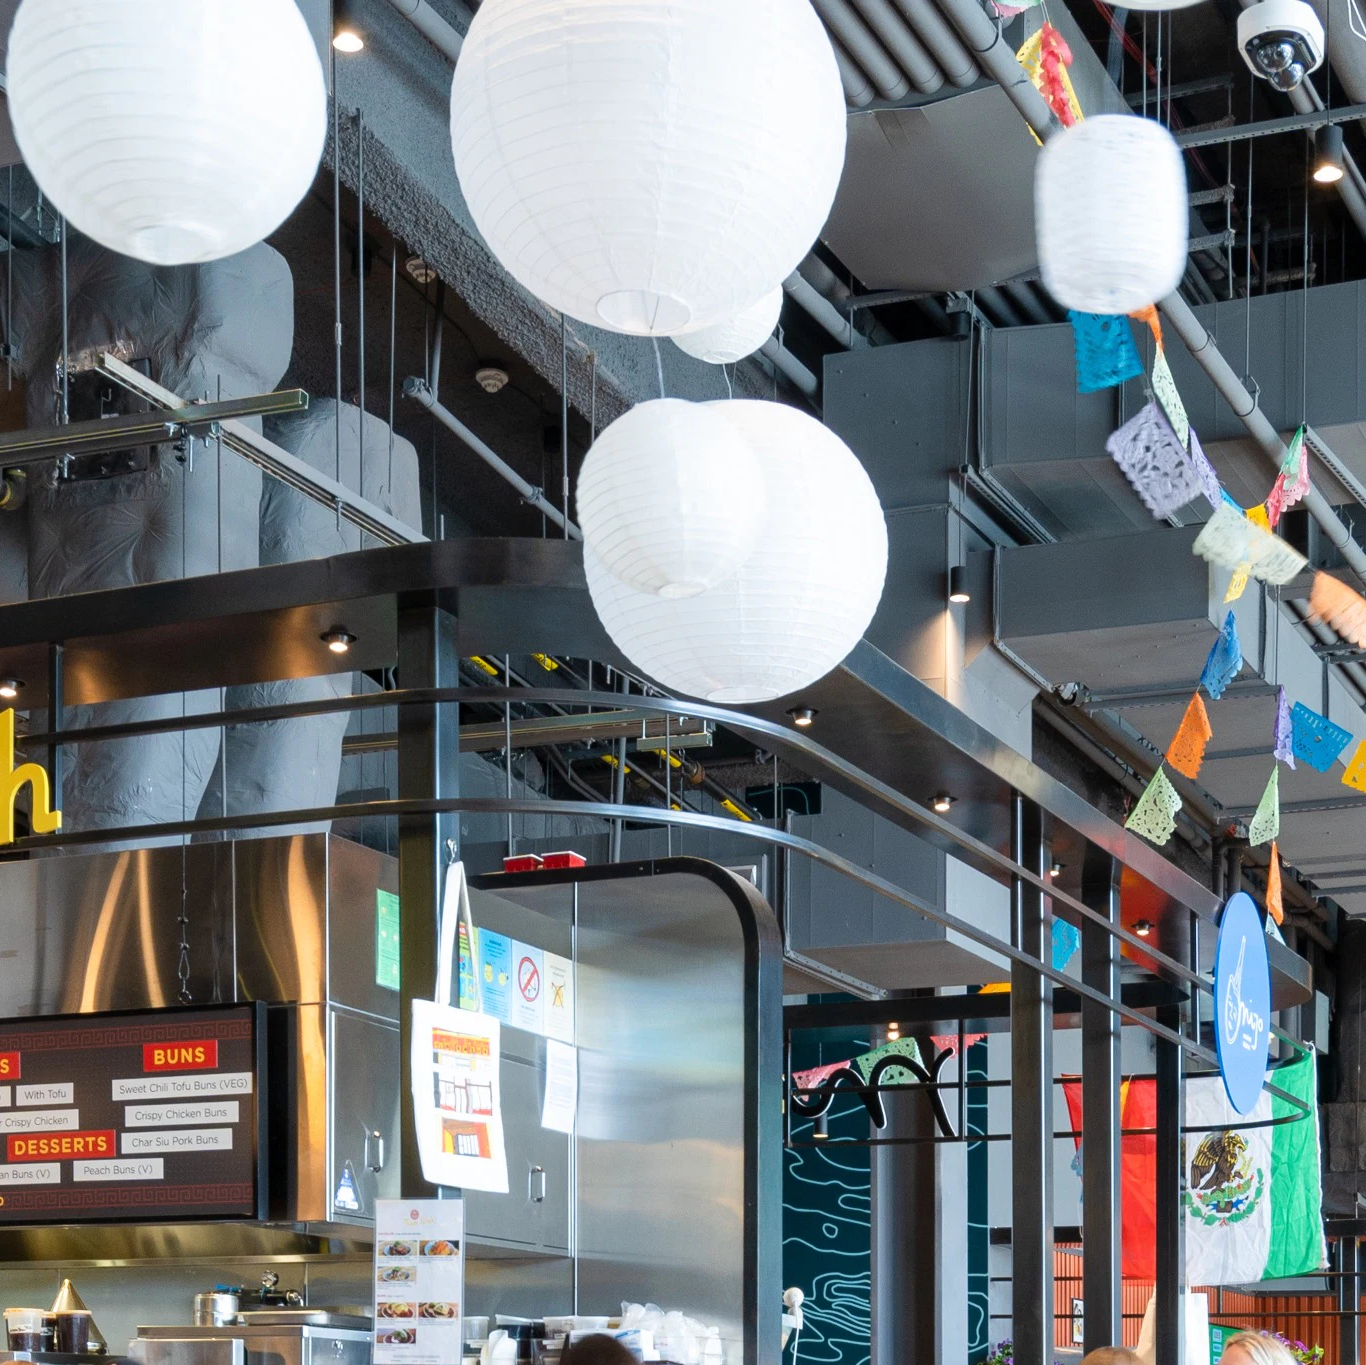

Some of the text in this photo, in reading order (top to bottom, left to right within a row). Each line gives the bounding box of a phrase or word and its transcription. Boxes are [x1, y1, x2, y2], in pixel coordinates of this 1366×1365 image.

[154, 1047, 204, 1065] BUNS
[119, 1079, 247, 1094] Sweet Chili Tofu Buns (VEG)
[25, 1089, 66, 1099] With Tofu
[135, 1108, 227, 1121] Crispy Chicken Buns
[5, 1118, 31, 1127] Crispy
[35, 1116, 68, 1126] Chicken
[14, 1136, 107, 1155] DESSERTS
[132, 1135, 218, 1147] Char Siu Pork Buns
[12, 1170, 33, 1178] Buns
[36, 1169, 50, 1179] (V)
[84, 1164, 152, 1175] Peach Buns (V)
